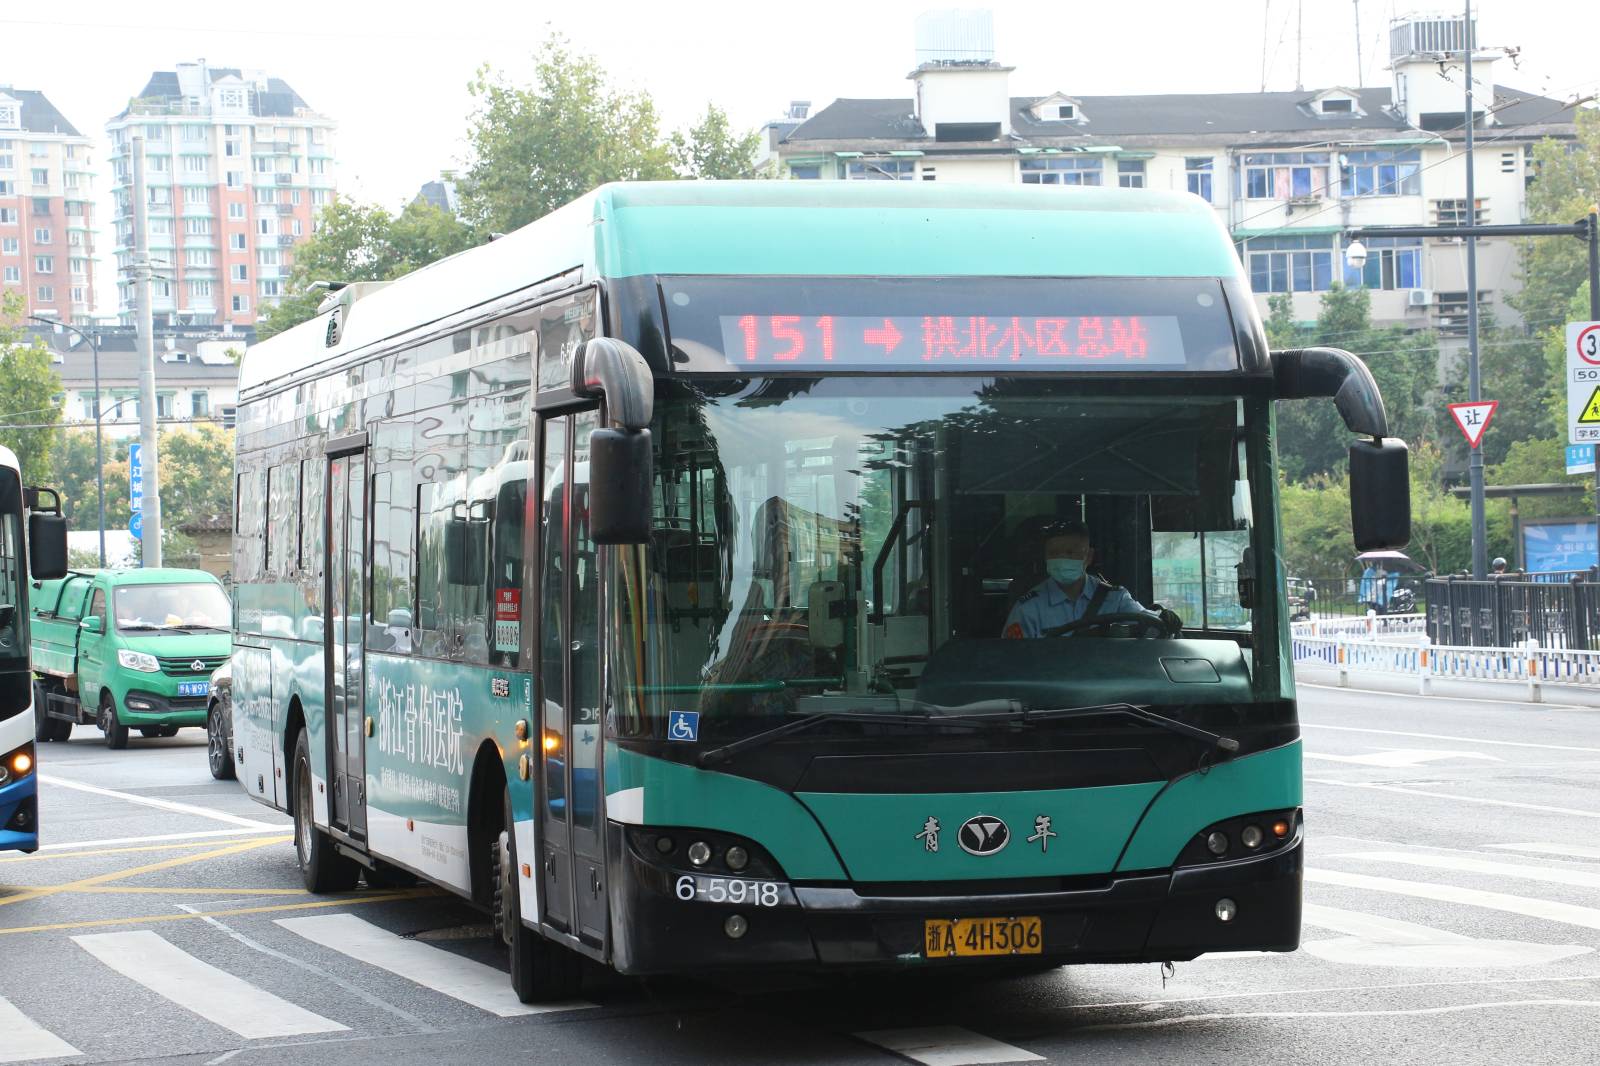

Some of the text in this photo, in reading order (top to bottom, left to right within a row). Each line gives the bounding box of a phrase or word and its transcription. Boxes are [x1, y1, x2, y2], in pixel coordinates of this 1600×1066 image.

[738, 315, 1148, 360] 151 拱北小区总站
[1465, 408, 1482, 426] 让
[379, 676, 464, 776] 浙江骨伤医院
[675, 875, 779, 907] 6-5918
[927, 922, 1041, 952] 浙A·4H306
